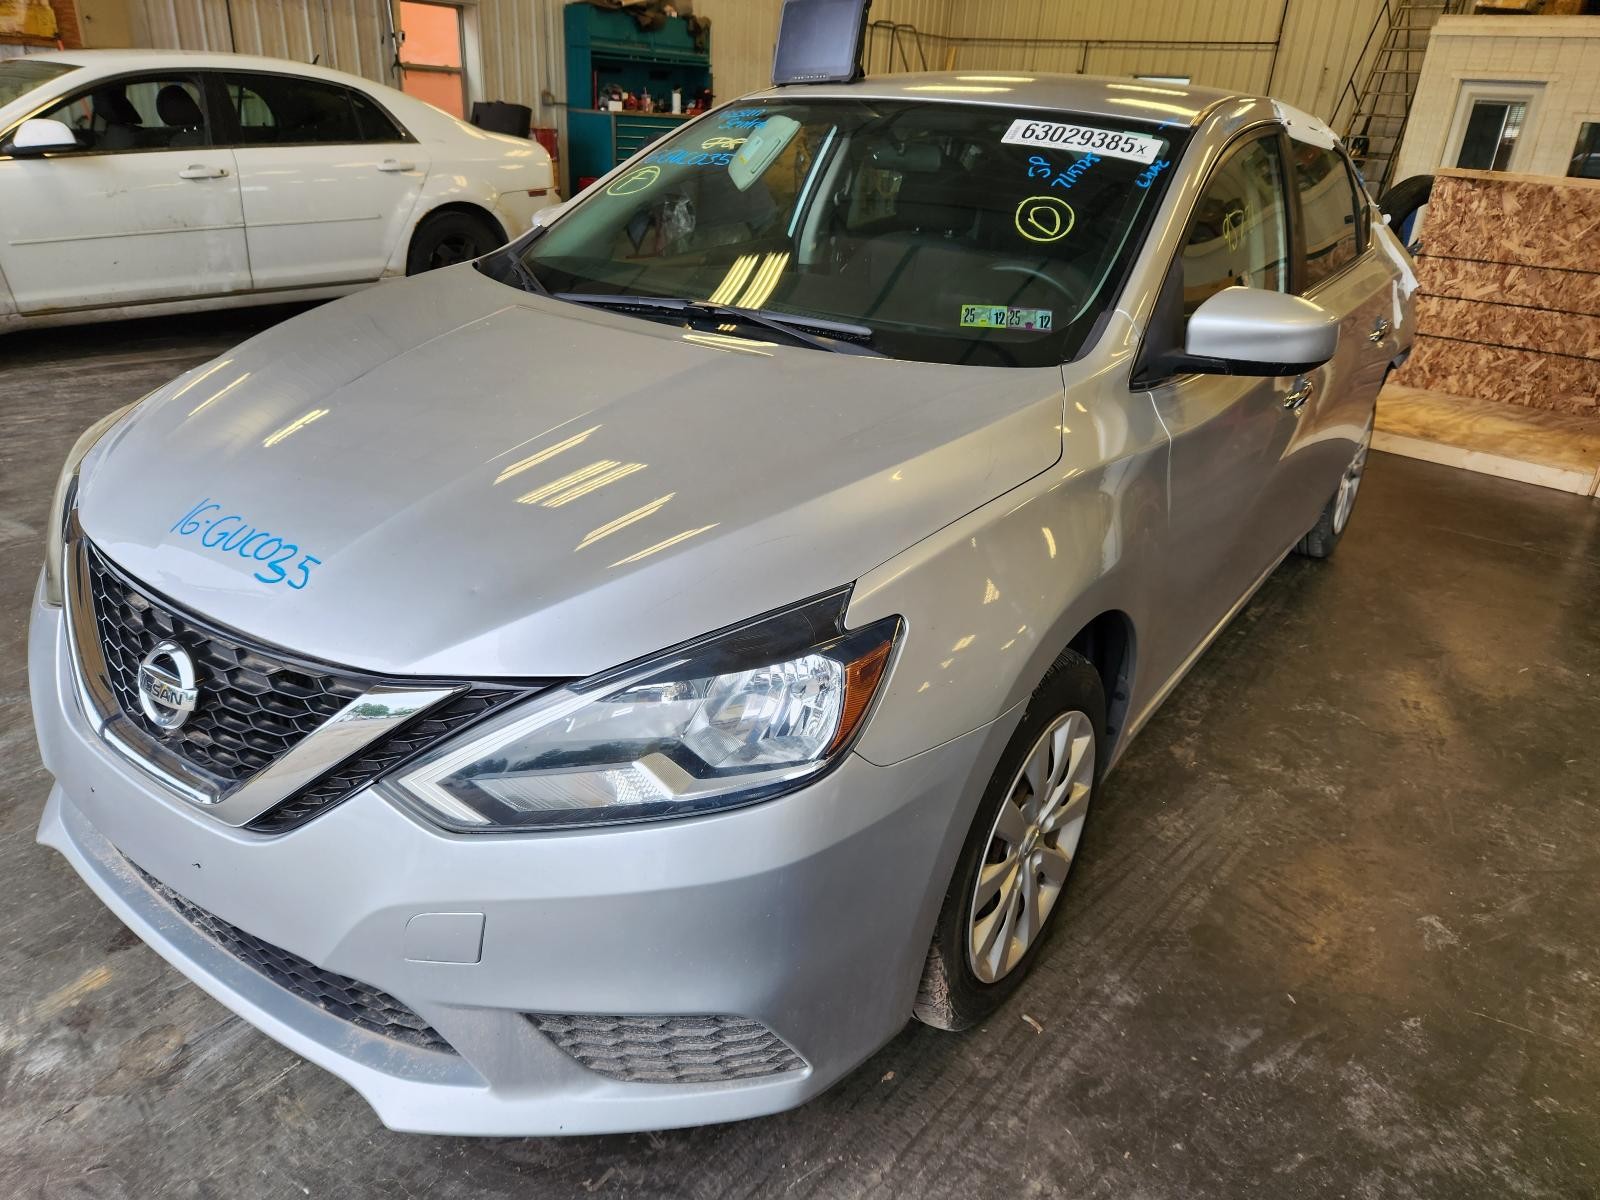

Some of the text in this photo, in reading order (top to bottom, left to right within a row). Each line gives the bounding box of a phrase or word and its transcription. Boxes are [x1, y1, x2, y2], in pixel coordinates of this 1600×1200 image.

[1021, 122, 1138, 153] 63029385
[964, 308, 1006, 326] 25 12
[1009, 310, 1051, 329] 25 12
